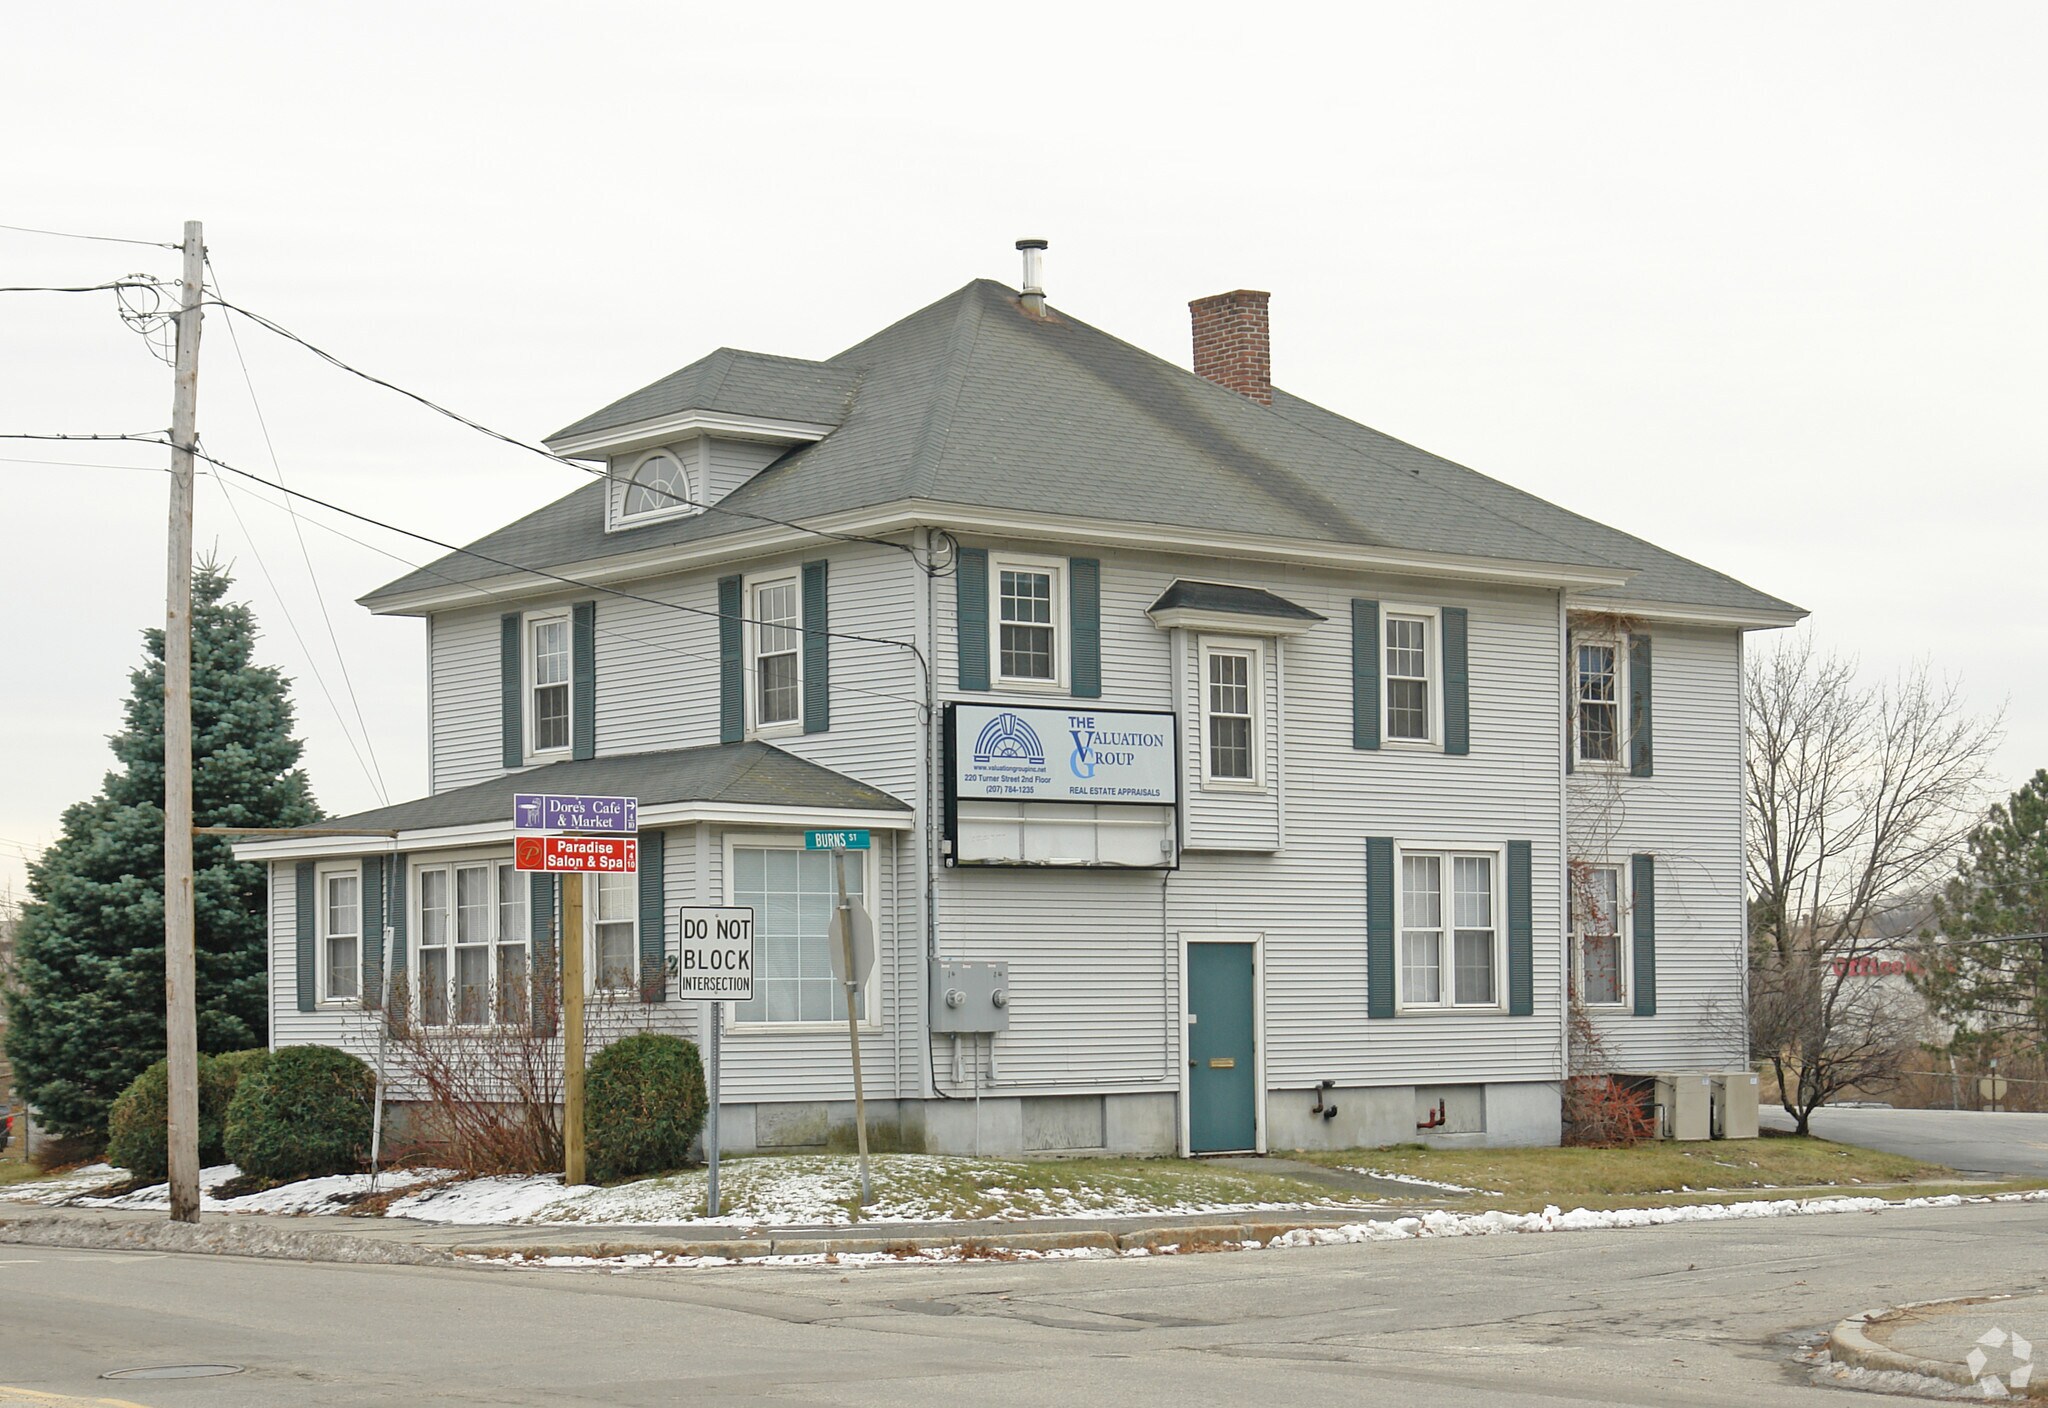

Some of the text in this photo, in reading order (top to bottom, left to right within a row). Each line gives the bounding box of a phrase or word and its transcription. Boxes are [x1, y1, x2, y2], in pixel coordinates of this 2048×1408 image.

[1068, 716, 1095, 729] THE
[1069, 730, 1164, 763] VALUATION
[1070, 747, 1135, 779] GROUP
[964, 774, 1052, 784] 220 Turner Street 2nd Floor
[986, 785, 1035, 795] (207) 784-1235
[1069, 786, 1160, 797] REAL ESTATE APPRAISALS
[550, 799, 586, 813] Dore's
[557, 814, 613, 828] & Market
[627, 821, 635, 829] 10
[557, 841, 613, 853] Paradise
[815, 832, 857, 848] BURNS ST
[547, 854, 623, 870] Salon & Spa
[684, 919, 751, 939] DO NOT
[684, 949, 750, 970] BLOCK
[682, 976, 750, 991] INTERSECTION
